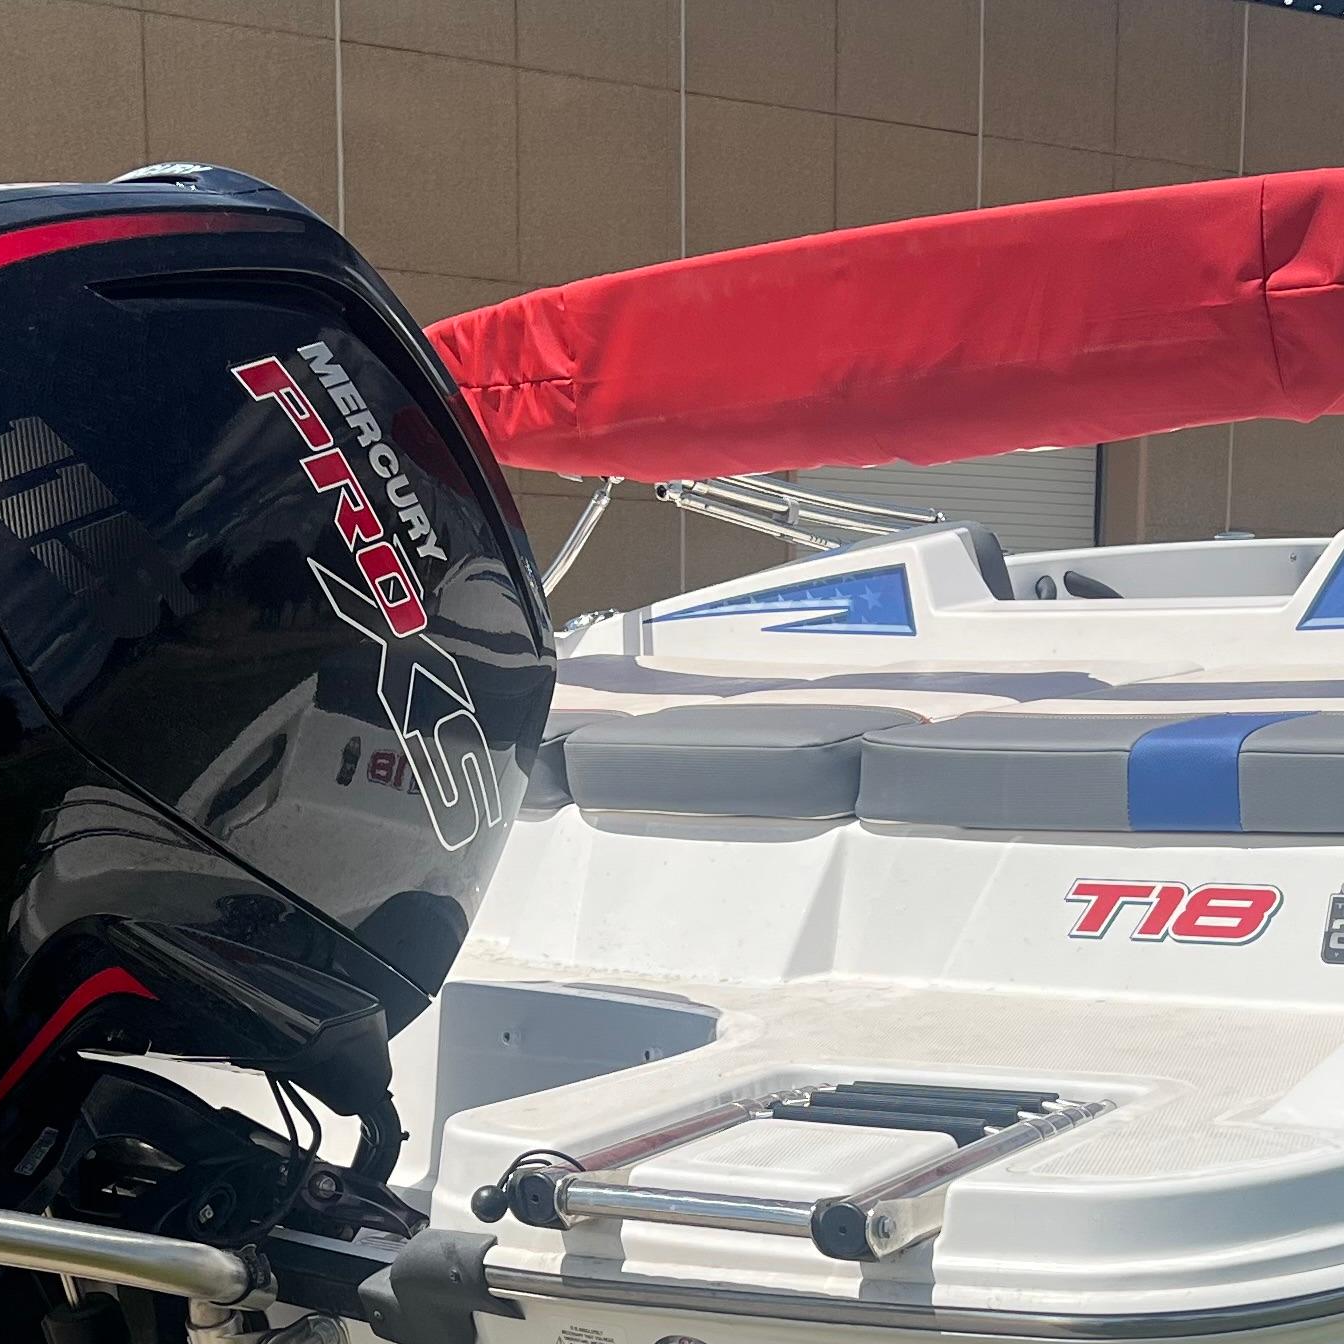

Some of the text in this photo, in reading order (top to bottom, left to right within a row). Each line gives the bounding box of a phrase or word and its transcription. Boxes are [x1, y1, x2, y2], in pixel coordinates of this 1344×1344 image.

[230, 356, 427, 638] PRO
[297, 340, 447, 562] MERCURY
[1064, 878, 1285, 947] T18
